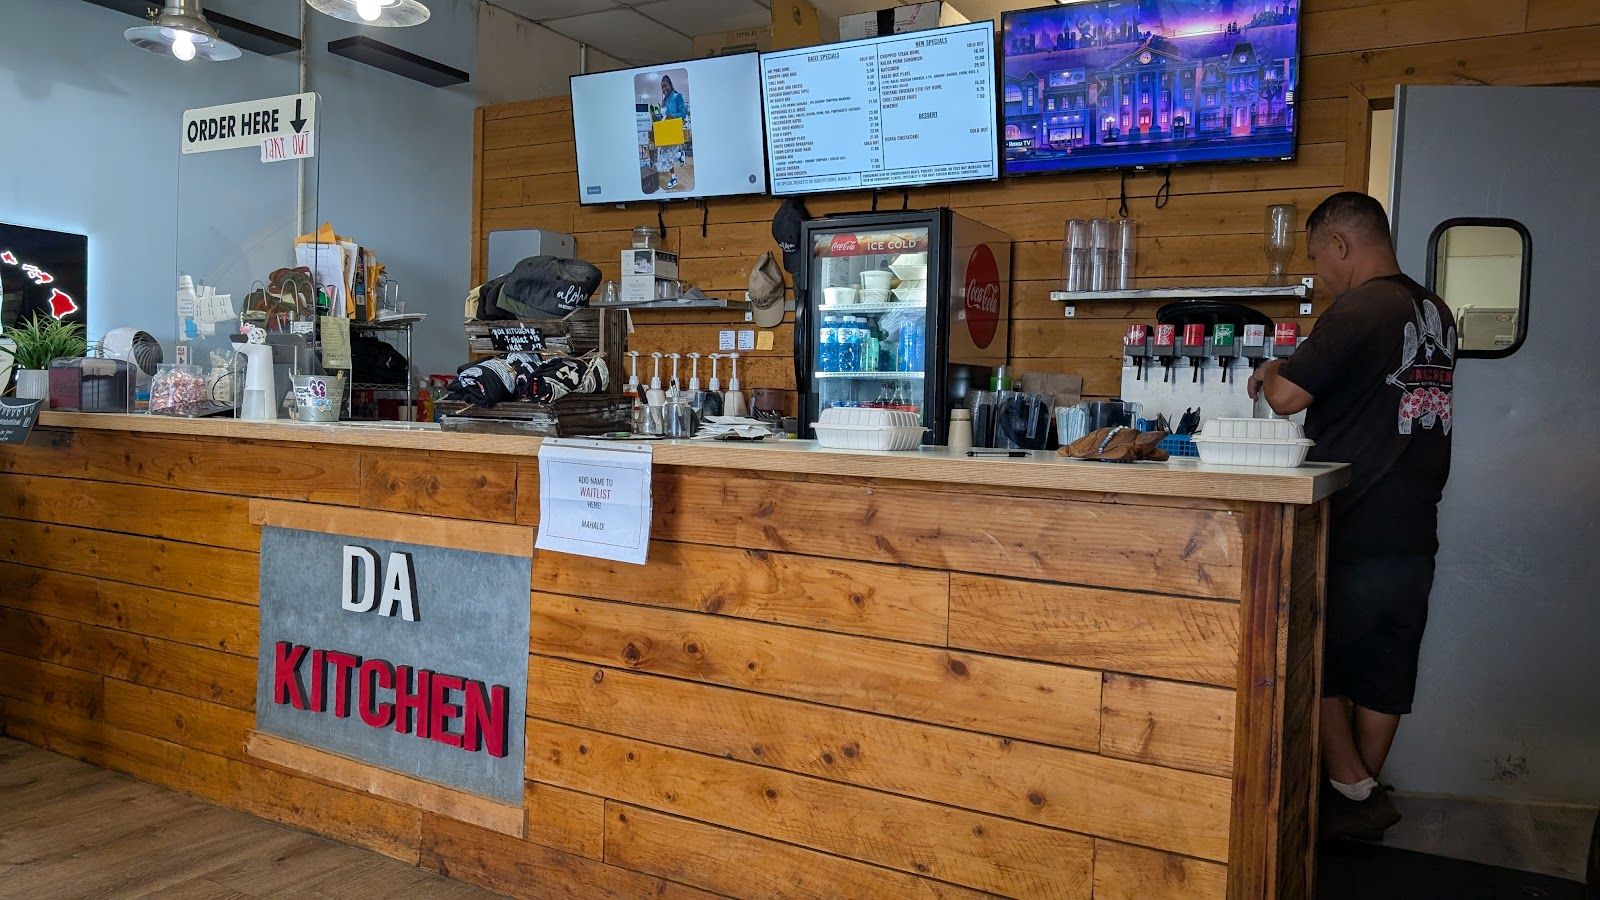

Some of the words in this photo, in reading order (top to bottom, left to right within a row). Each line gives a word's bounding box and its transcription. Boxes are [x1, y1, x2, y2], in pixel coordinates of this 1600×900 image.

[926, 38, 947, 46] SPECIALS
[188, 116, 236, 142] ORDER
[241, 109, 279, 136] HERE
[292, 131, 310, 155] OUT
[868, 241, 884, 251] ICE
[888, 240, 917, 249] COLD
[967, 279, 1000, 312] Coca-Cola
[578, 476, 590, 484] ADD
[590, 478, 605, 486] NAME
[606, 478, 613, 486] TO
[580, 487, 611, 499] WAITLIST
[587, 501, 602, 509] HERE!
[581, 520, 605, 530] MAHALO!
[342, 545, 421, 622] DA
[274, 640, 510, 758] KITCHEN
